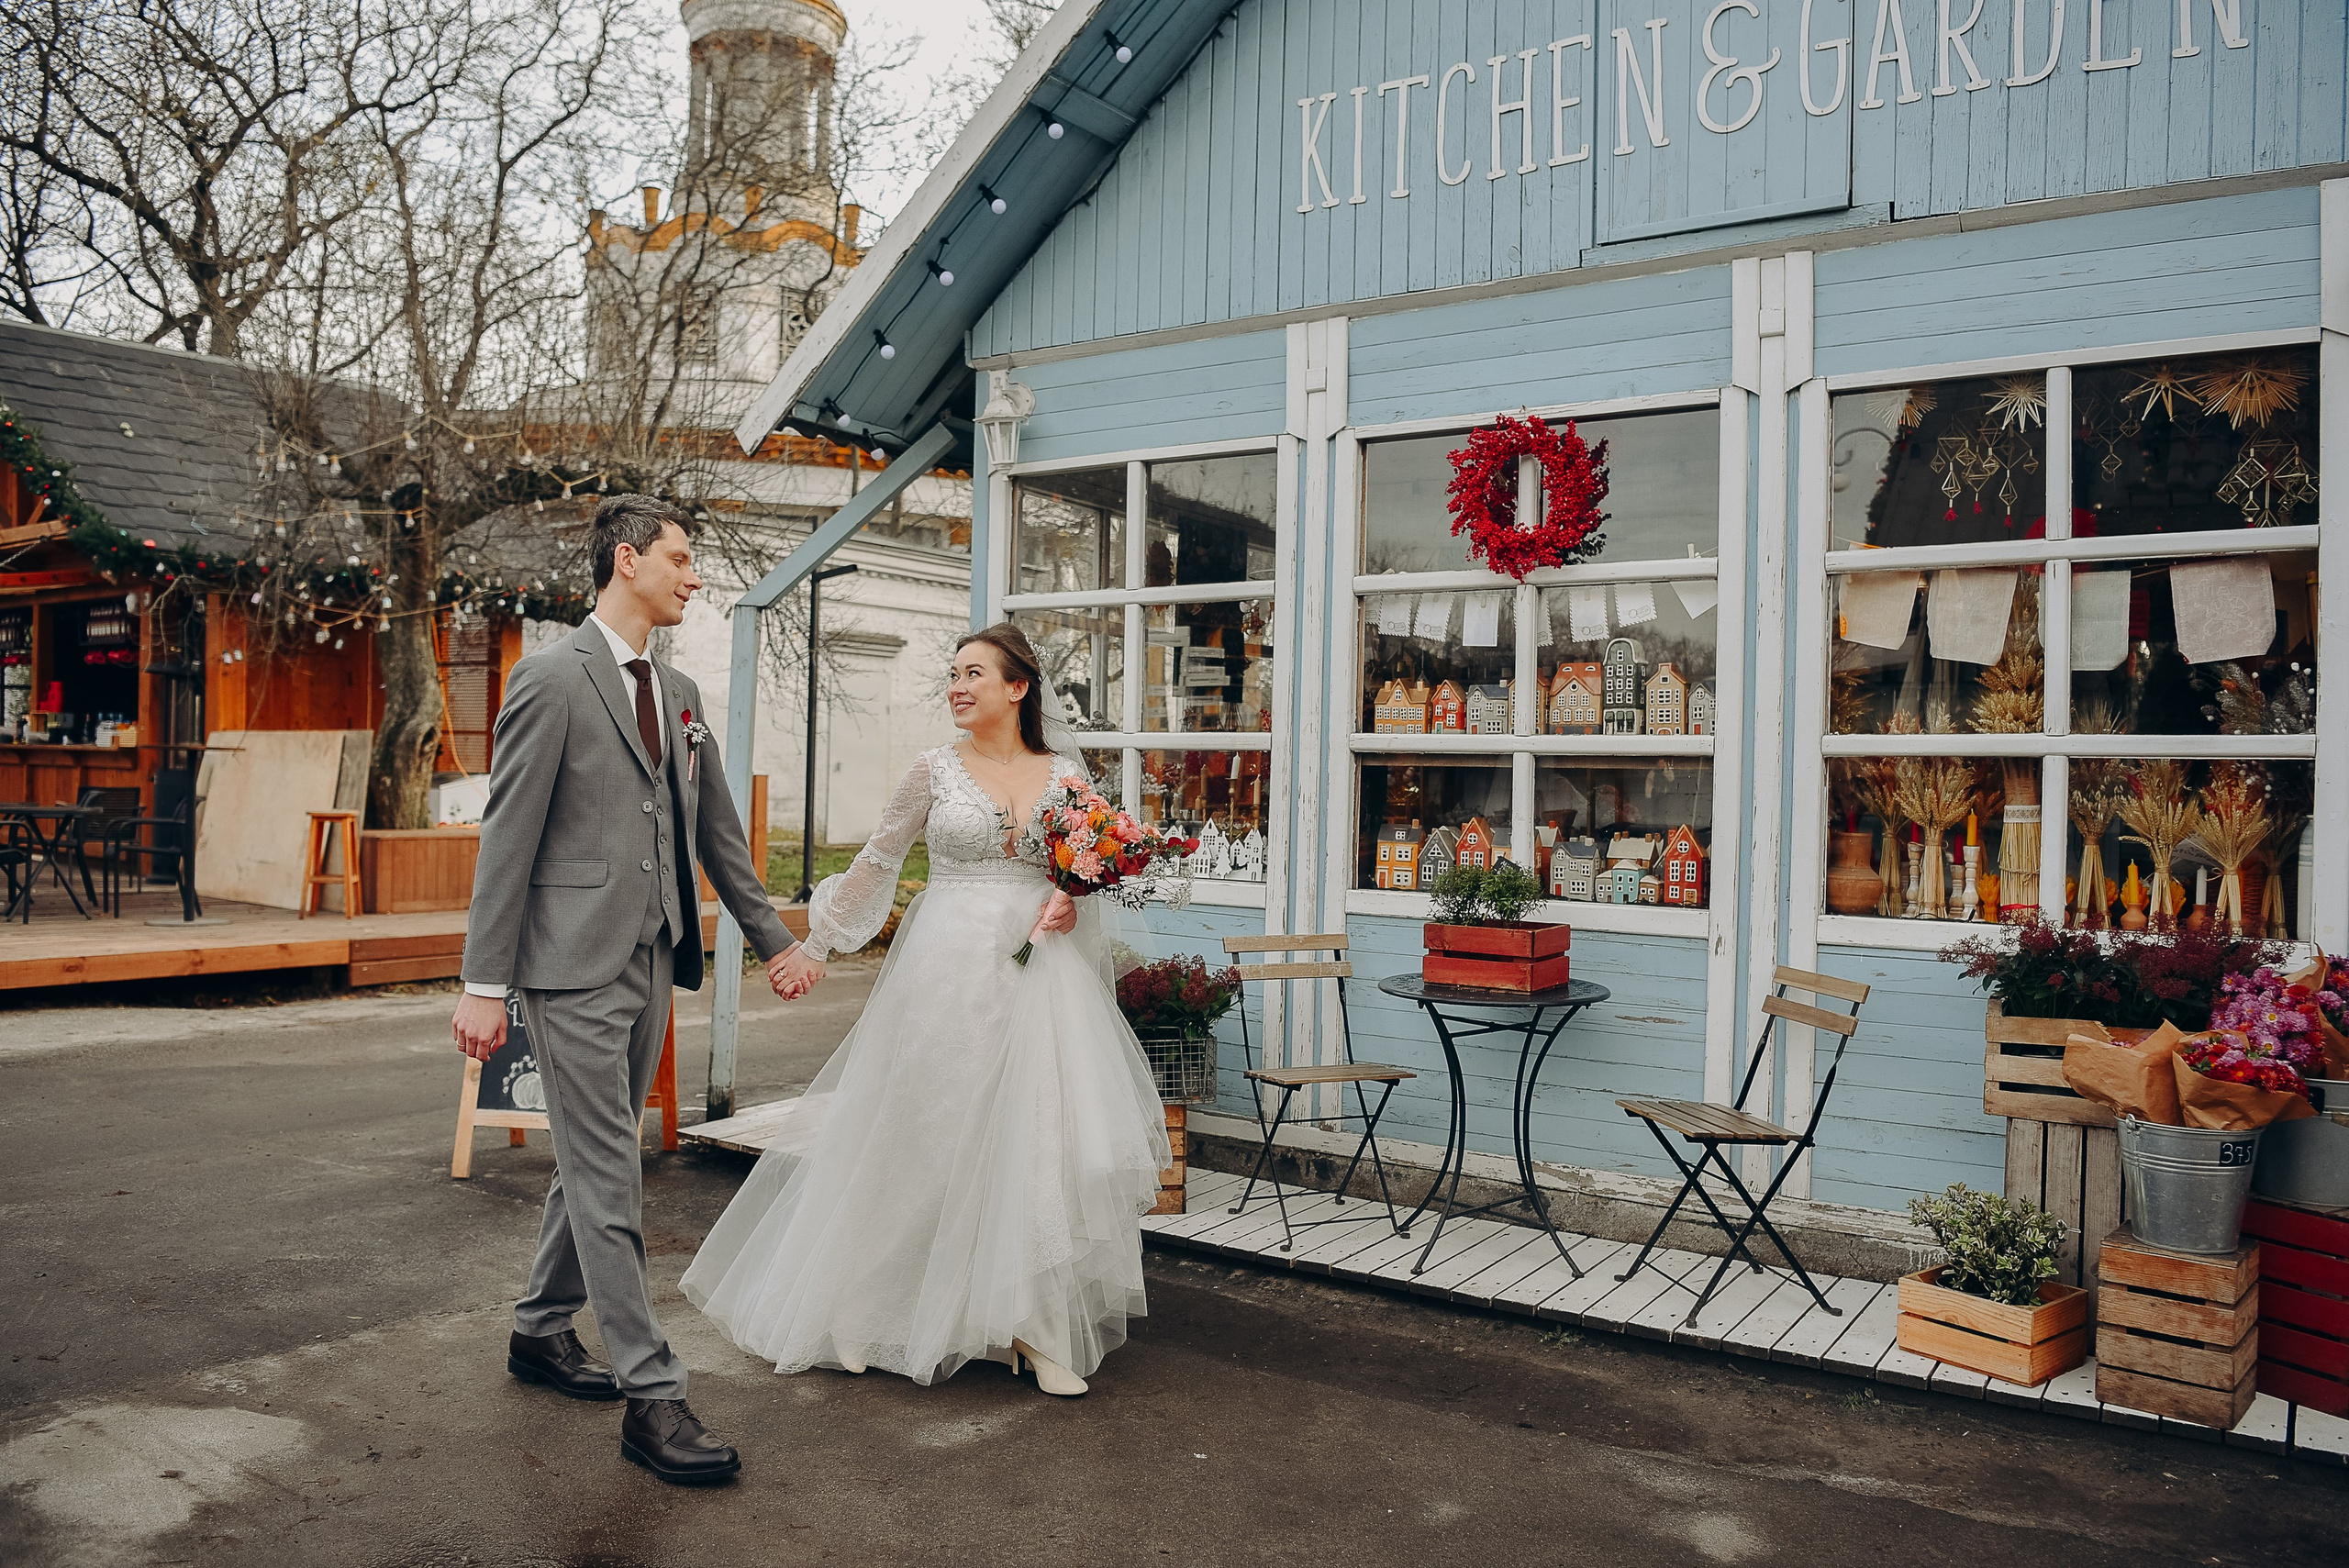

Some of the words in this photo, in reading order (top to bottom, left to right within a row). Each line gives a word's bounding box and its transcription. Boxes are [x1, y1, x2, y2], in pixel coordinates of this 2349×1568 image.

[1296, 17, 1671, 213] KITCHEN
[1696, 0, 1782, 134] &
[2221, 1142, 2253, 1163] 375
